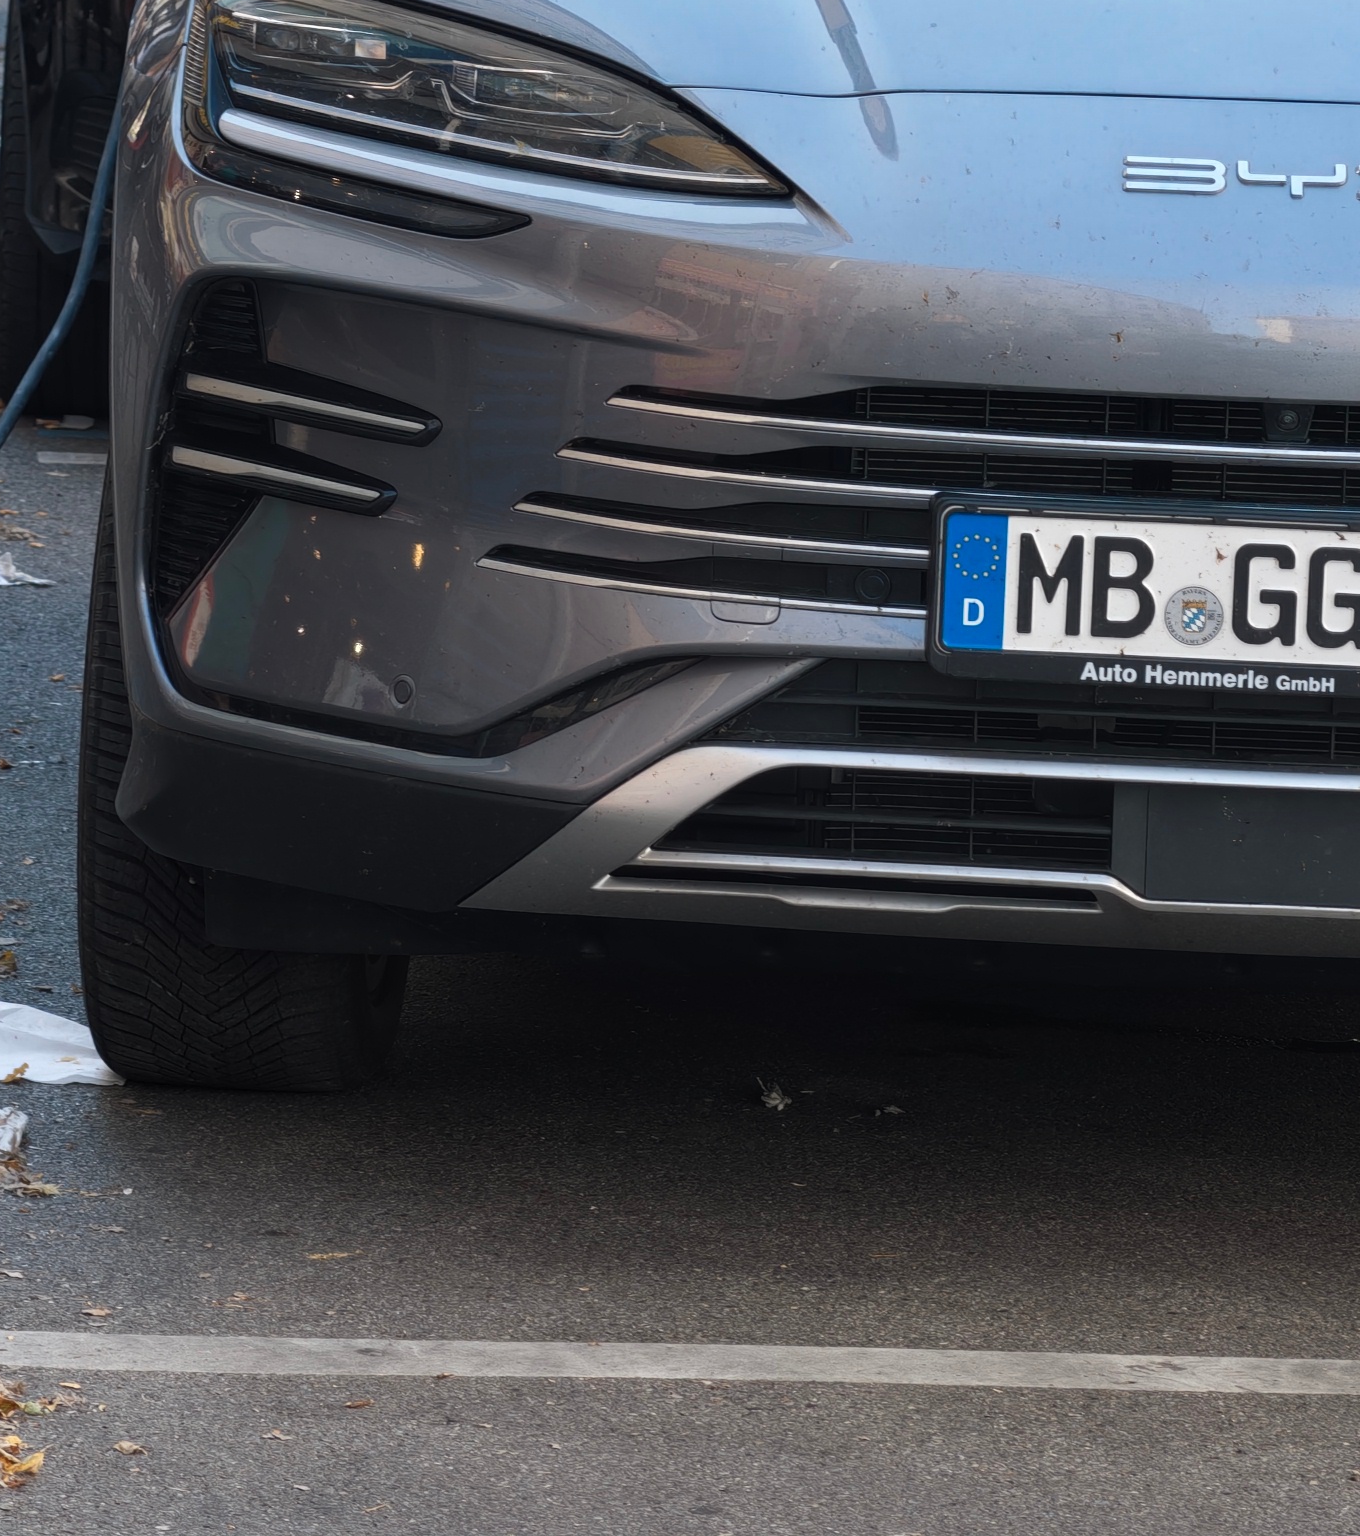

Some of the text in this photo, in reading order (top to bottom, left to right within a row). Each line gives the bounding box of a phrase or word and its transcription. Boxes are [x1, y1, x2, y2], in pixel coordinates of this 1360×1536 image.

[1016, 532, 1157, 639] MB
[962, 598, 985, 627] D
[1080, 662, 1138, 684] Auto
[1144, 665, 1270, 690] Hemmerle
[1275, 675, 1335, 694] GmbH
